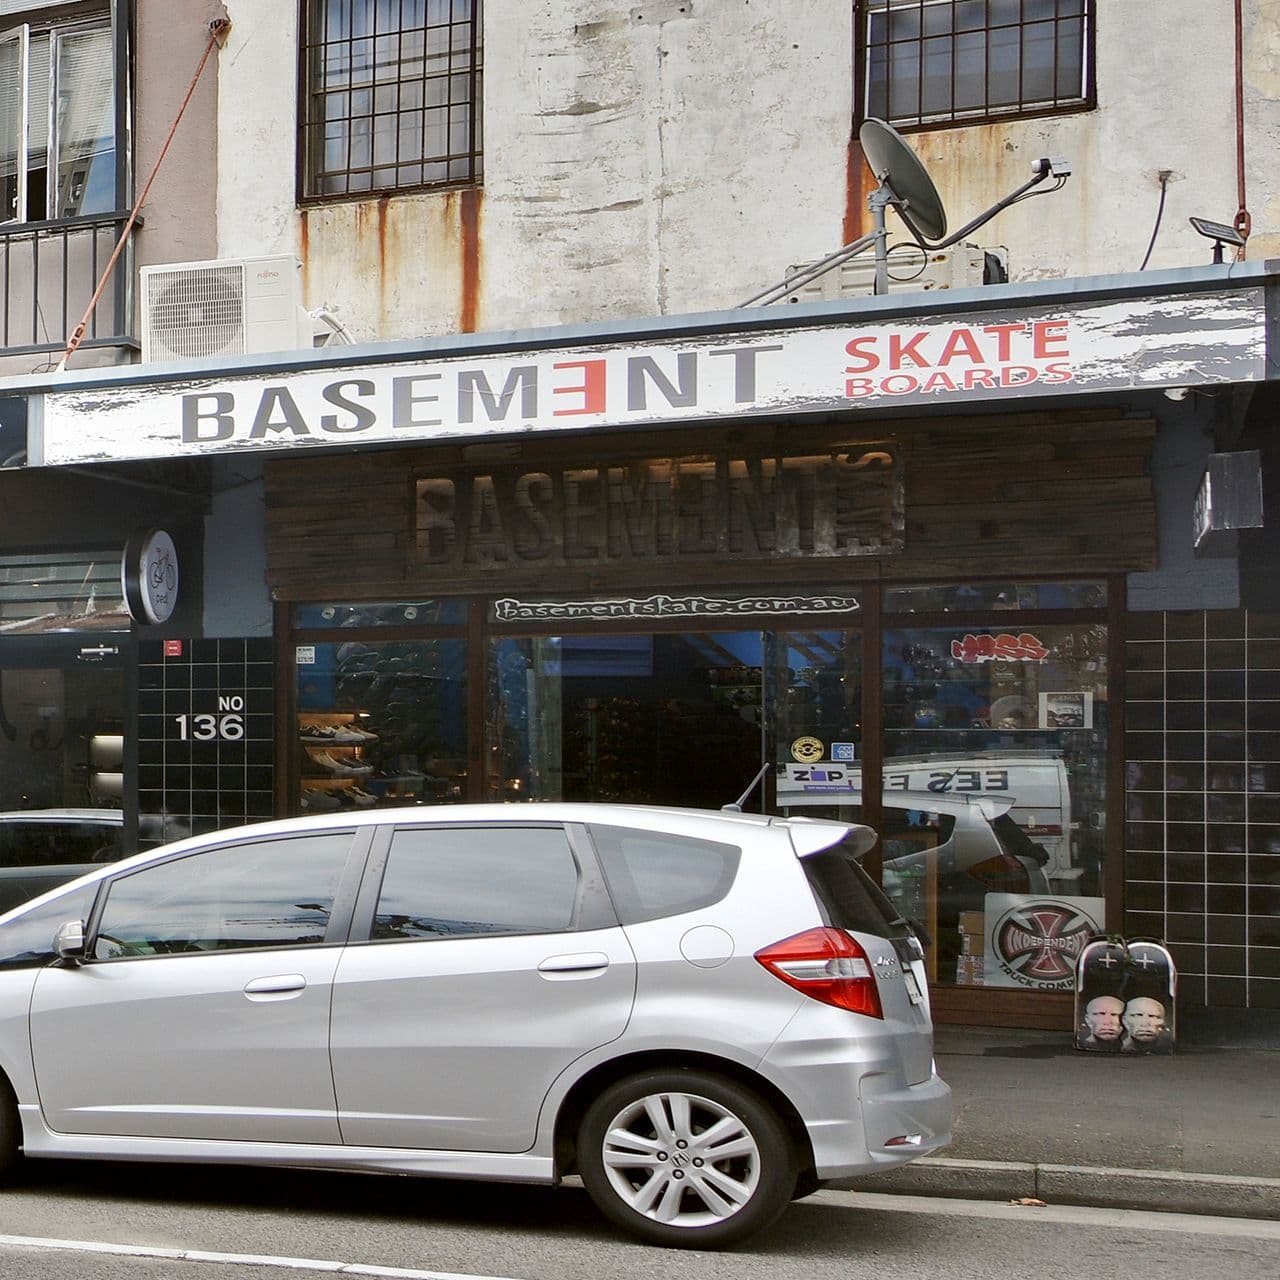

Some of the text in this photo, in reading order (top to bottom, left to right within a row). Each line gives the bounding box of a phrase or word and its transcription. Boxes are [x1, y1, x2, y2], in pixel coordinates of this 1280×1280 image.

[844, 321, 1071, 375] SKATE
[845, 362, 1074, 399] BOARDS
[218, 696, 244, 711] NO
[175, 714, 244, 741] 136
[1006, 925, 1088, 954] INDEPENDENT
[998, 961, 1033, 988] TRUCK
